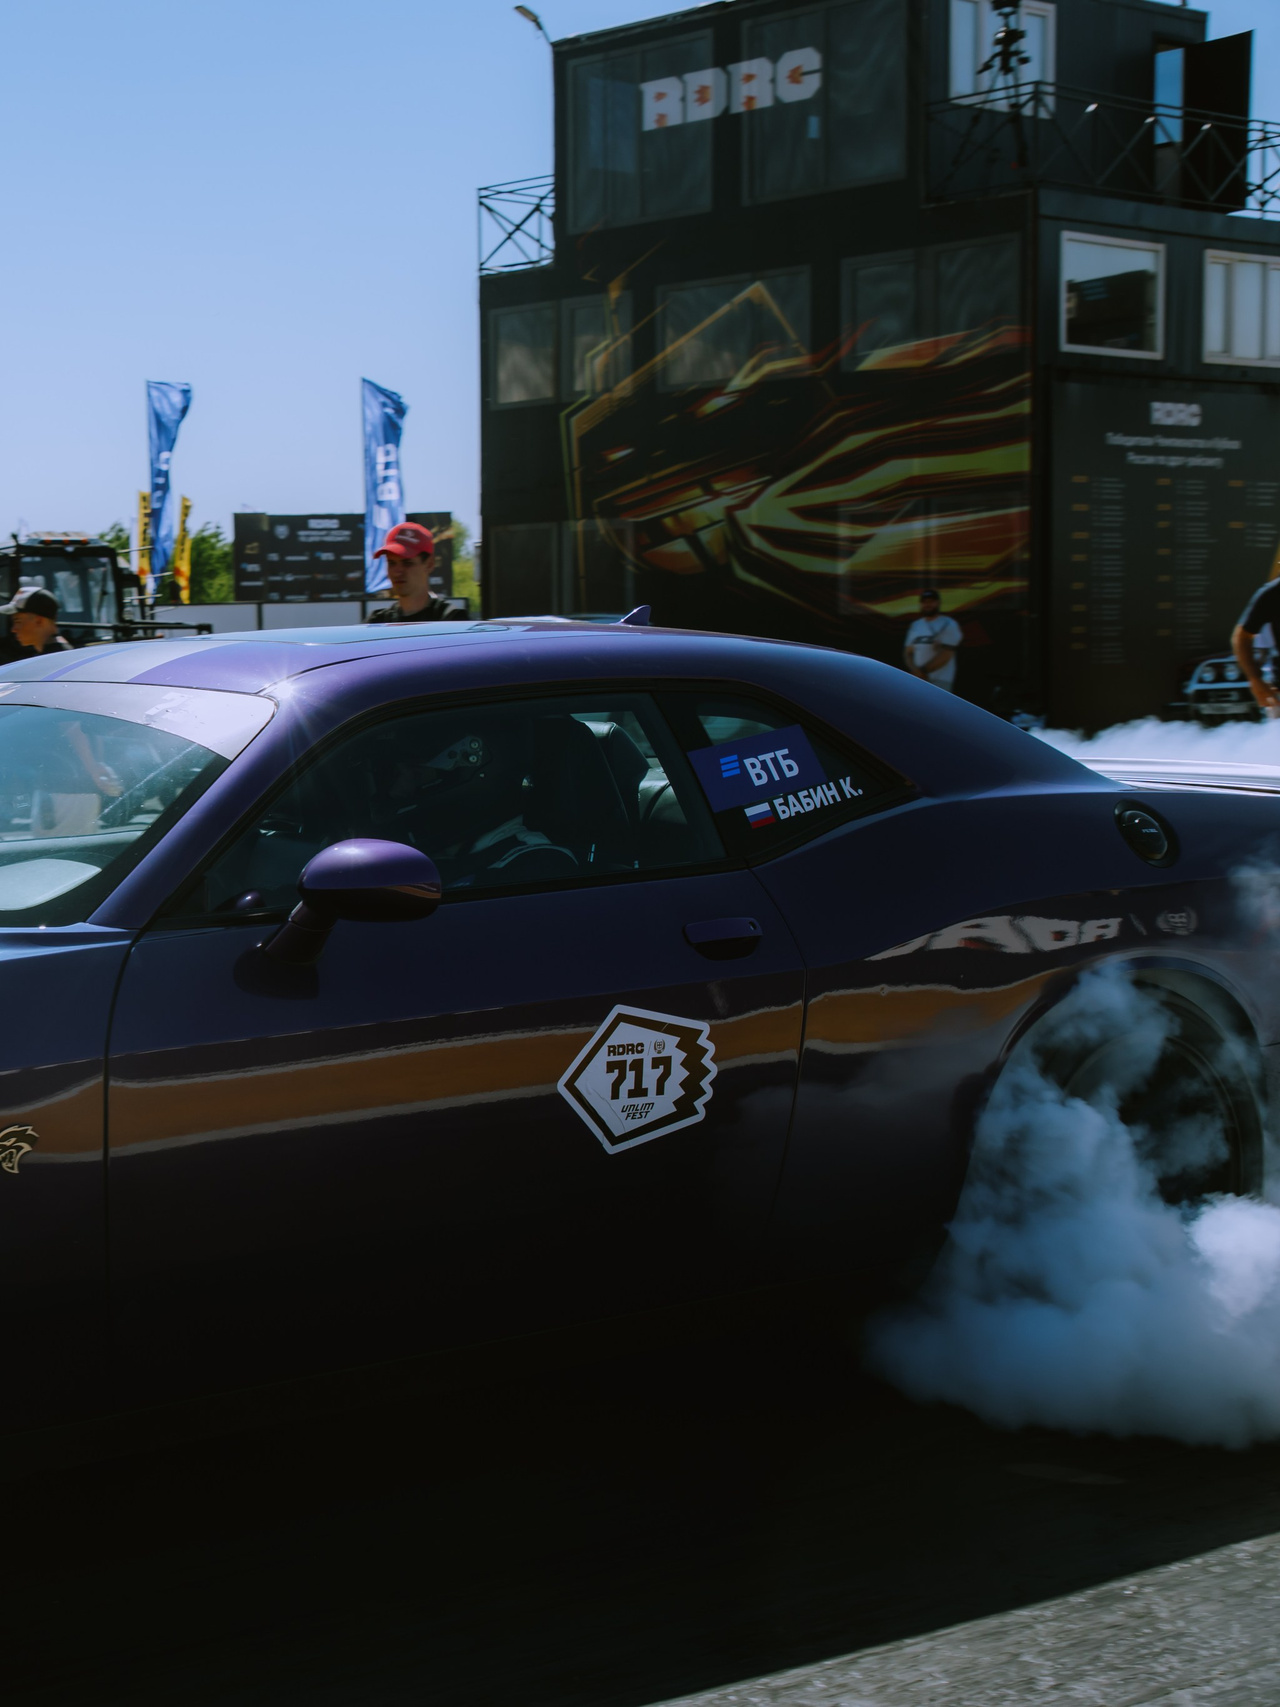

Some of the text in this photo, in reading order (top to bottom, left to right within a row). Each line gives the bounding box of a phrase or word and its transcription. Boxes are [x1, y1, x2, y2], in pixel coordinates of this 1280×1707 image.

[639, 46, 823, 132] RDRC
[743, 748, 800, 787] ВТБ
[772, 776, 864, 820] БАБИН К.
[607, 1043, 644, 1056] RDRC
[606, 1056, 672, 1100] 717
[622, 1103, 654, 1112] UNLIM
[626, 1111, 649, 1120] FEST
